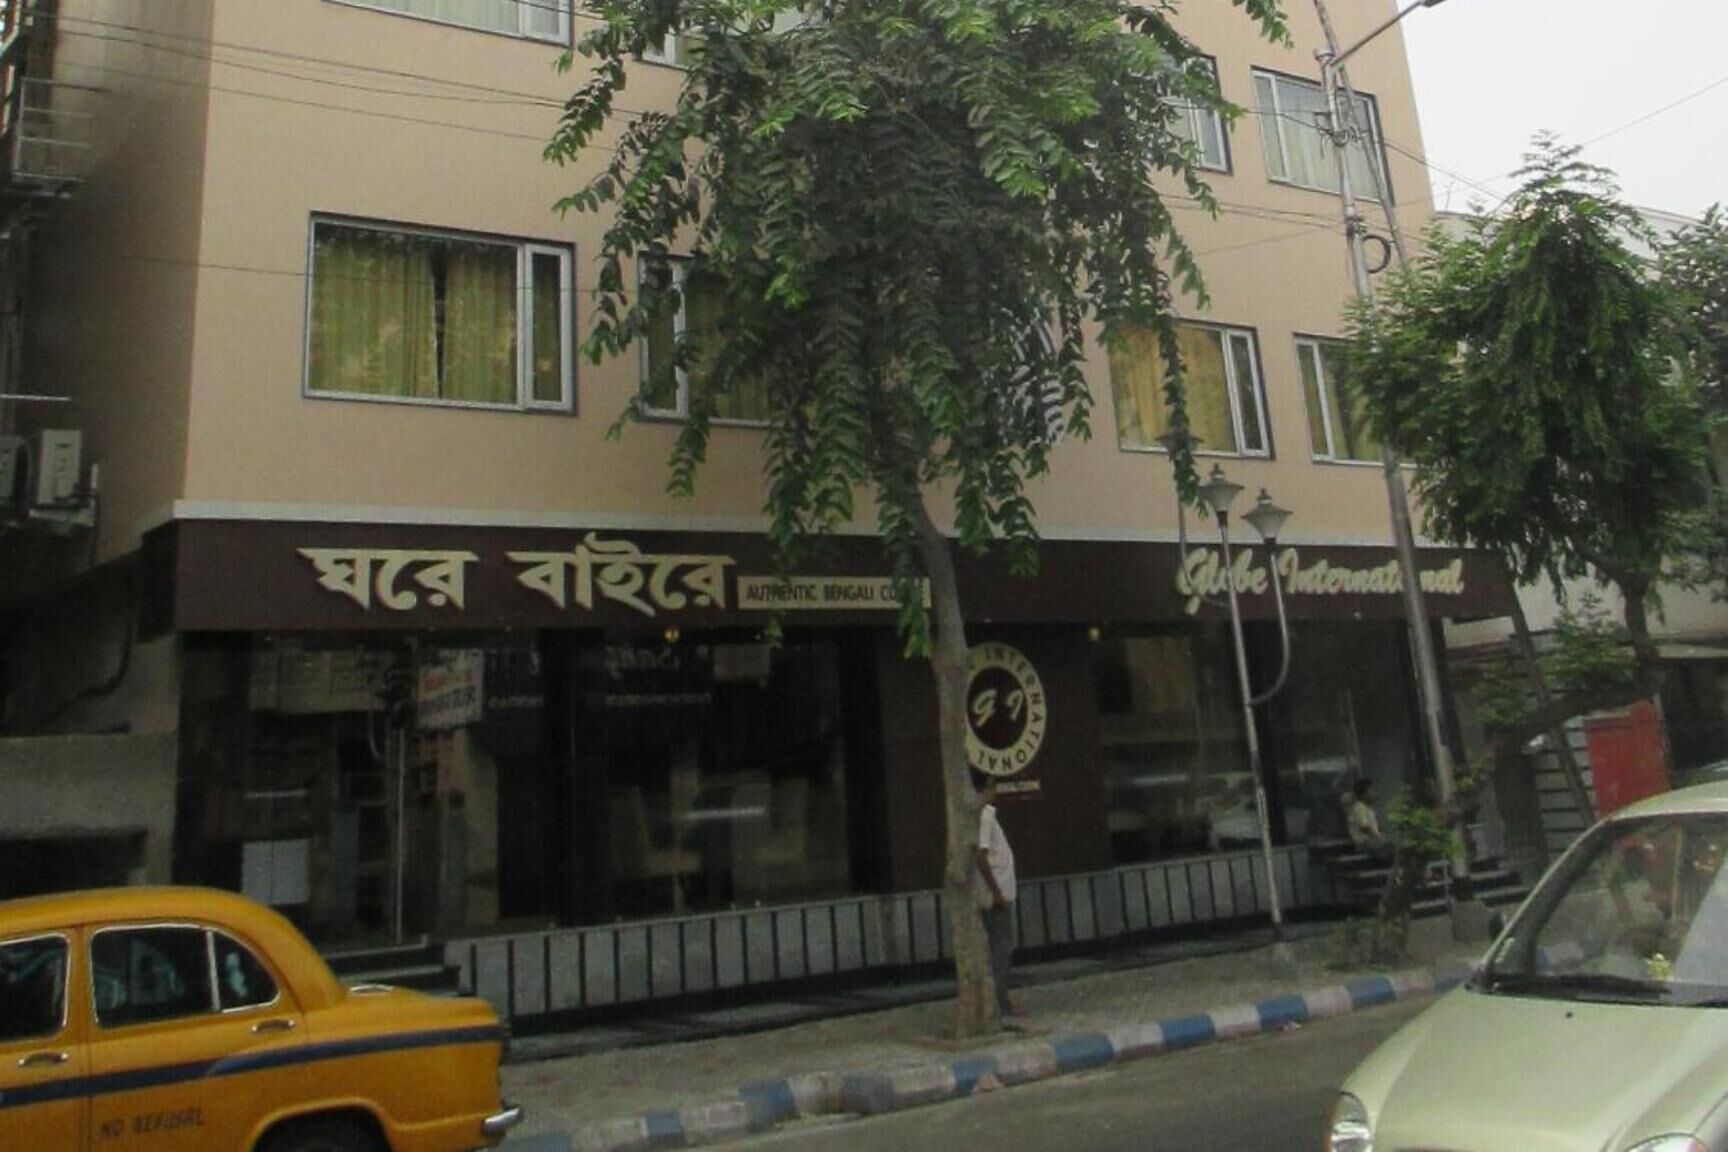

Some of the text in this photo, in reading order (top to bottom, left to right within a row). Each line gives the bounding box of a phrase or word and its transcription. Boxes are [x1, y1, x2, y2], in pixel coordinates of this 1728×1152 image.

[297, 531, 736, 617] ঘরে বাইরে
[823, 584, 875, 602] BENGALI
[1176, 546, 1269, 616] Globe
[101, 1106, 208, 1138] NO REFUSAL
